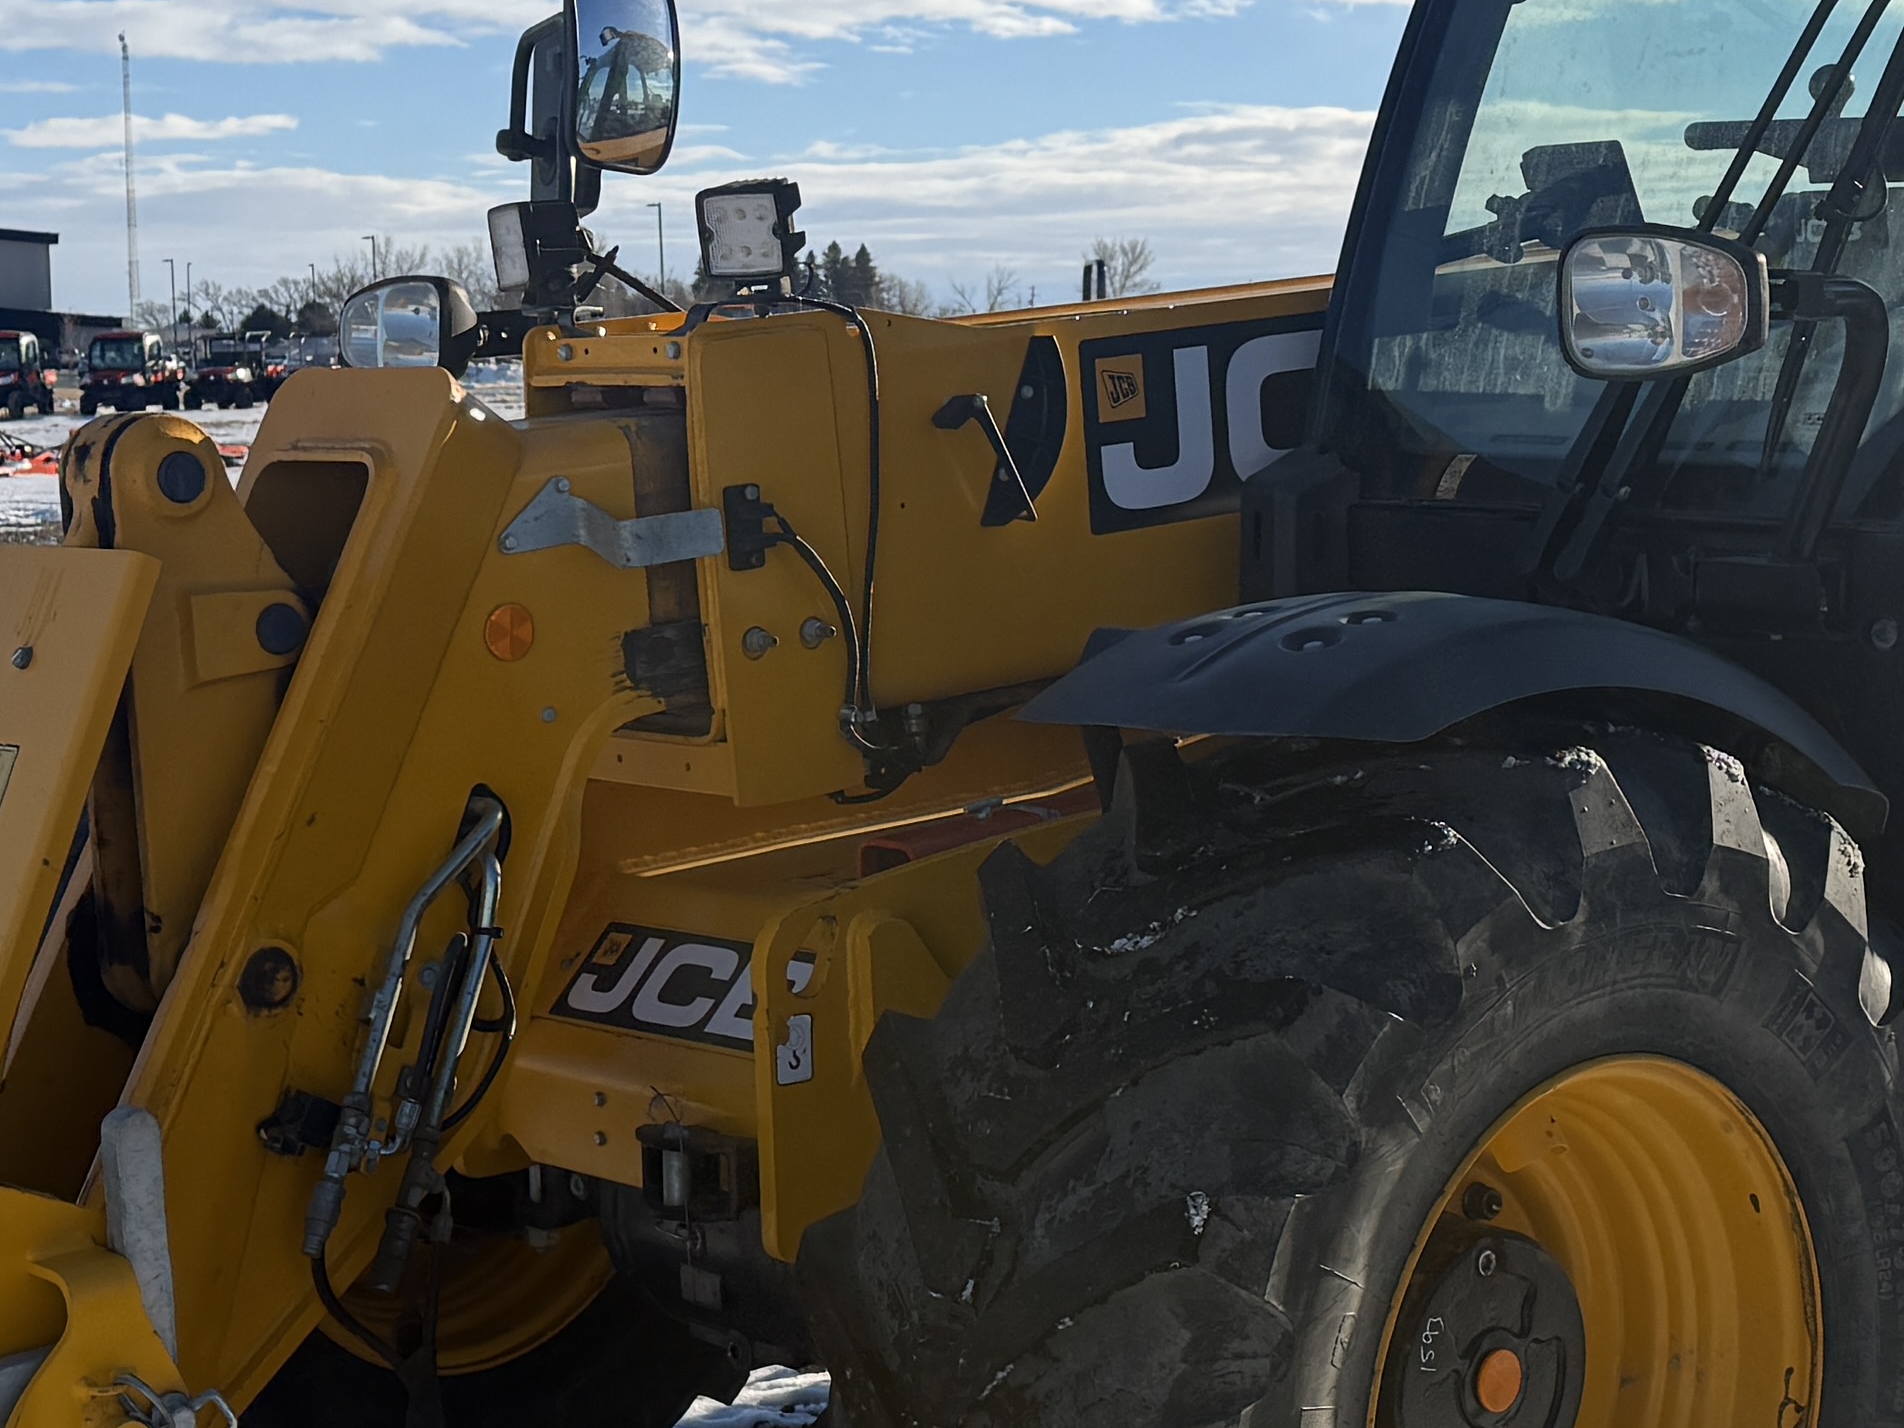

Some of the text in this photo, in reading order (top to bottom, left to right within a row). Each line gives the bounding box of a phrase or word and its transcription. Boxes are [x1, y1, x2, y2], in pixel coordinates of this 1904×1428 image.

[1109, 373, 1138, 403] JCB
[1100, 329, 1324, 510] JC
[1420, 1316, 1445, 1372] 1593
